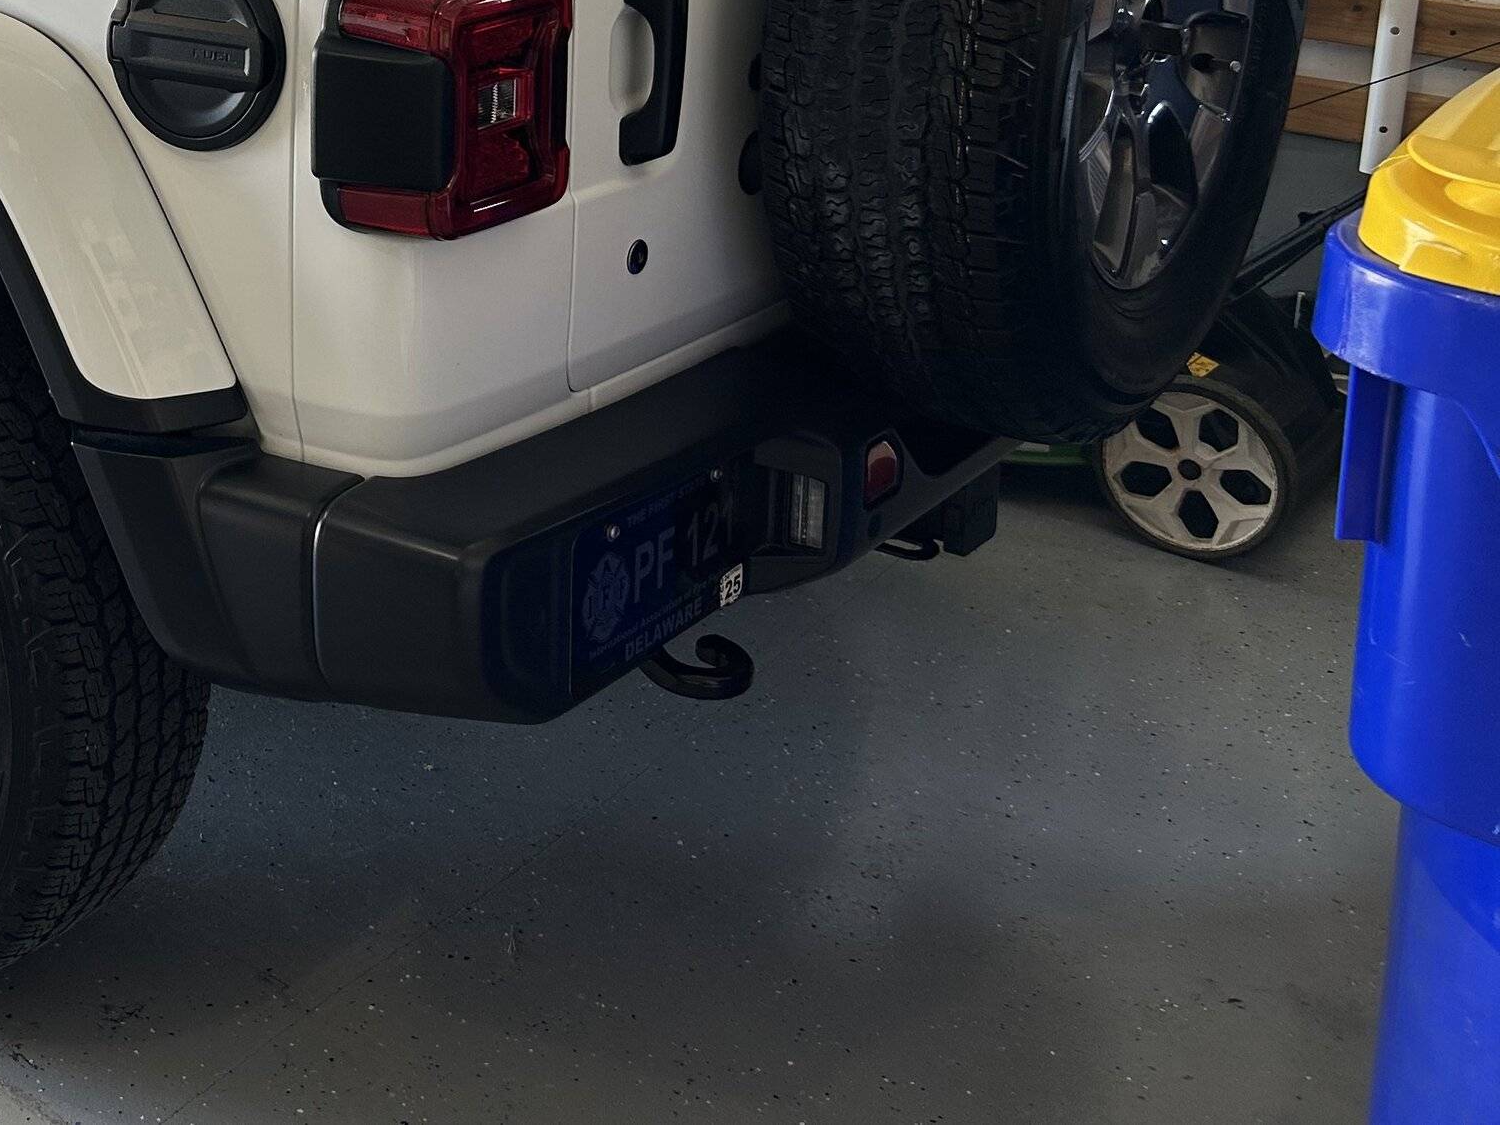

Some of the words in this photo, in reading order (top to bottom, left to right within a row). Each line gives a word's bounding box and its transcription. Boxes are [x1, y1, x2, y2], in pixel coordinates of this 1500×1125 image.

[634, 525, 676, 603] PF
[725, 574, 740, 600] 25
[625, 597, 703, 662] DELAWARE
